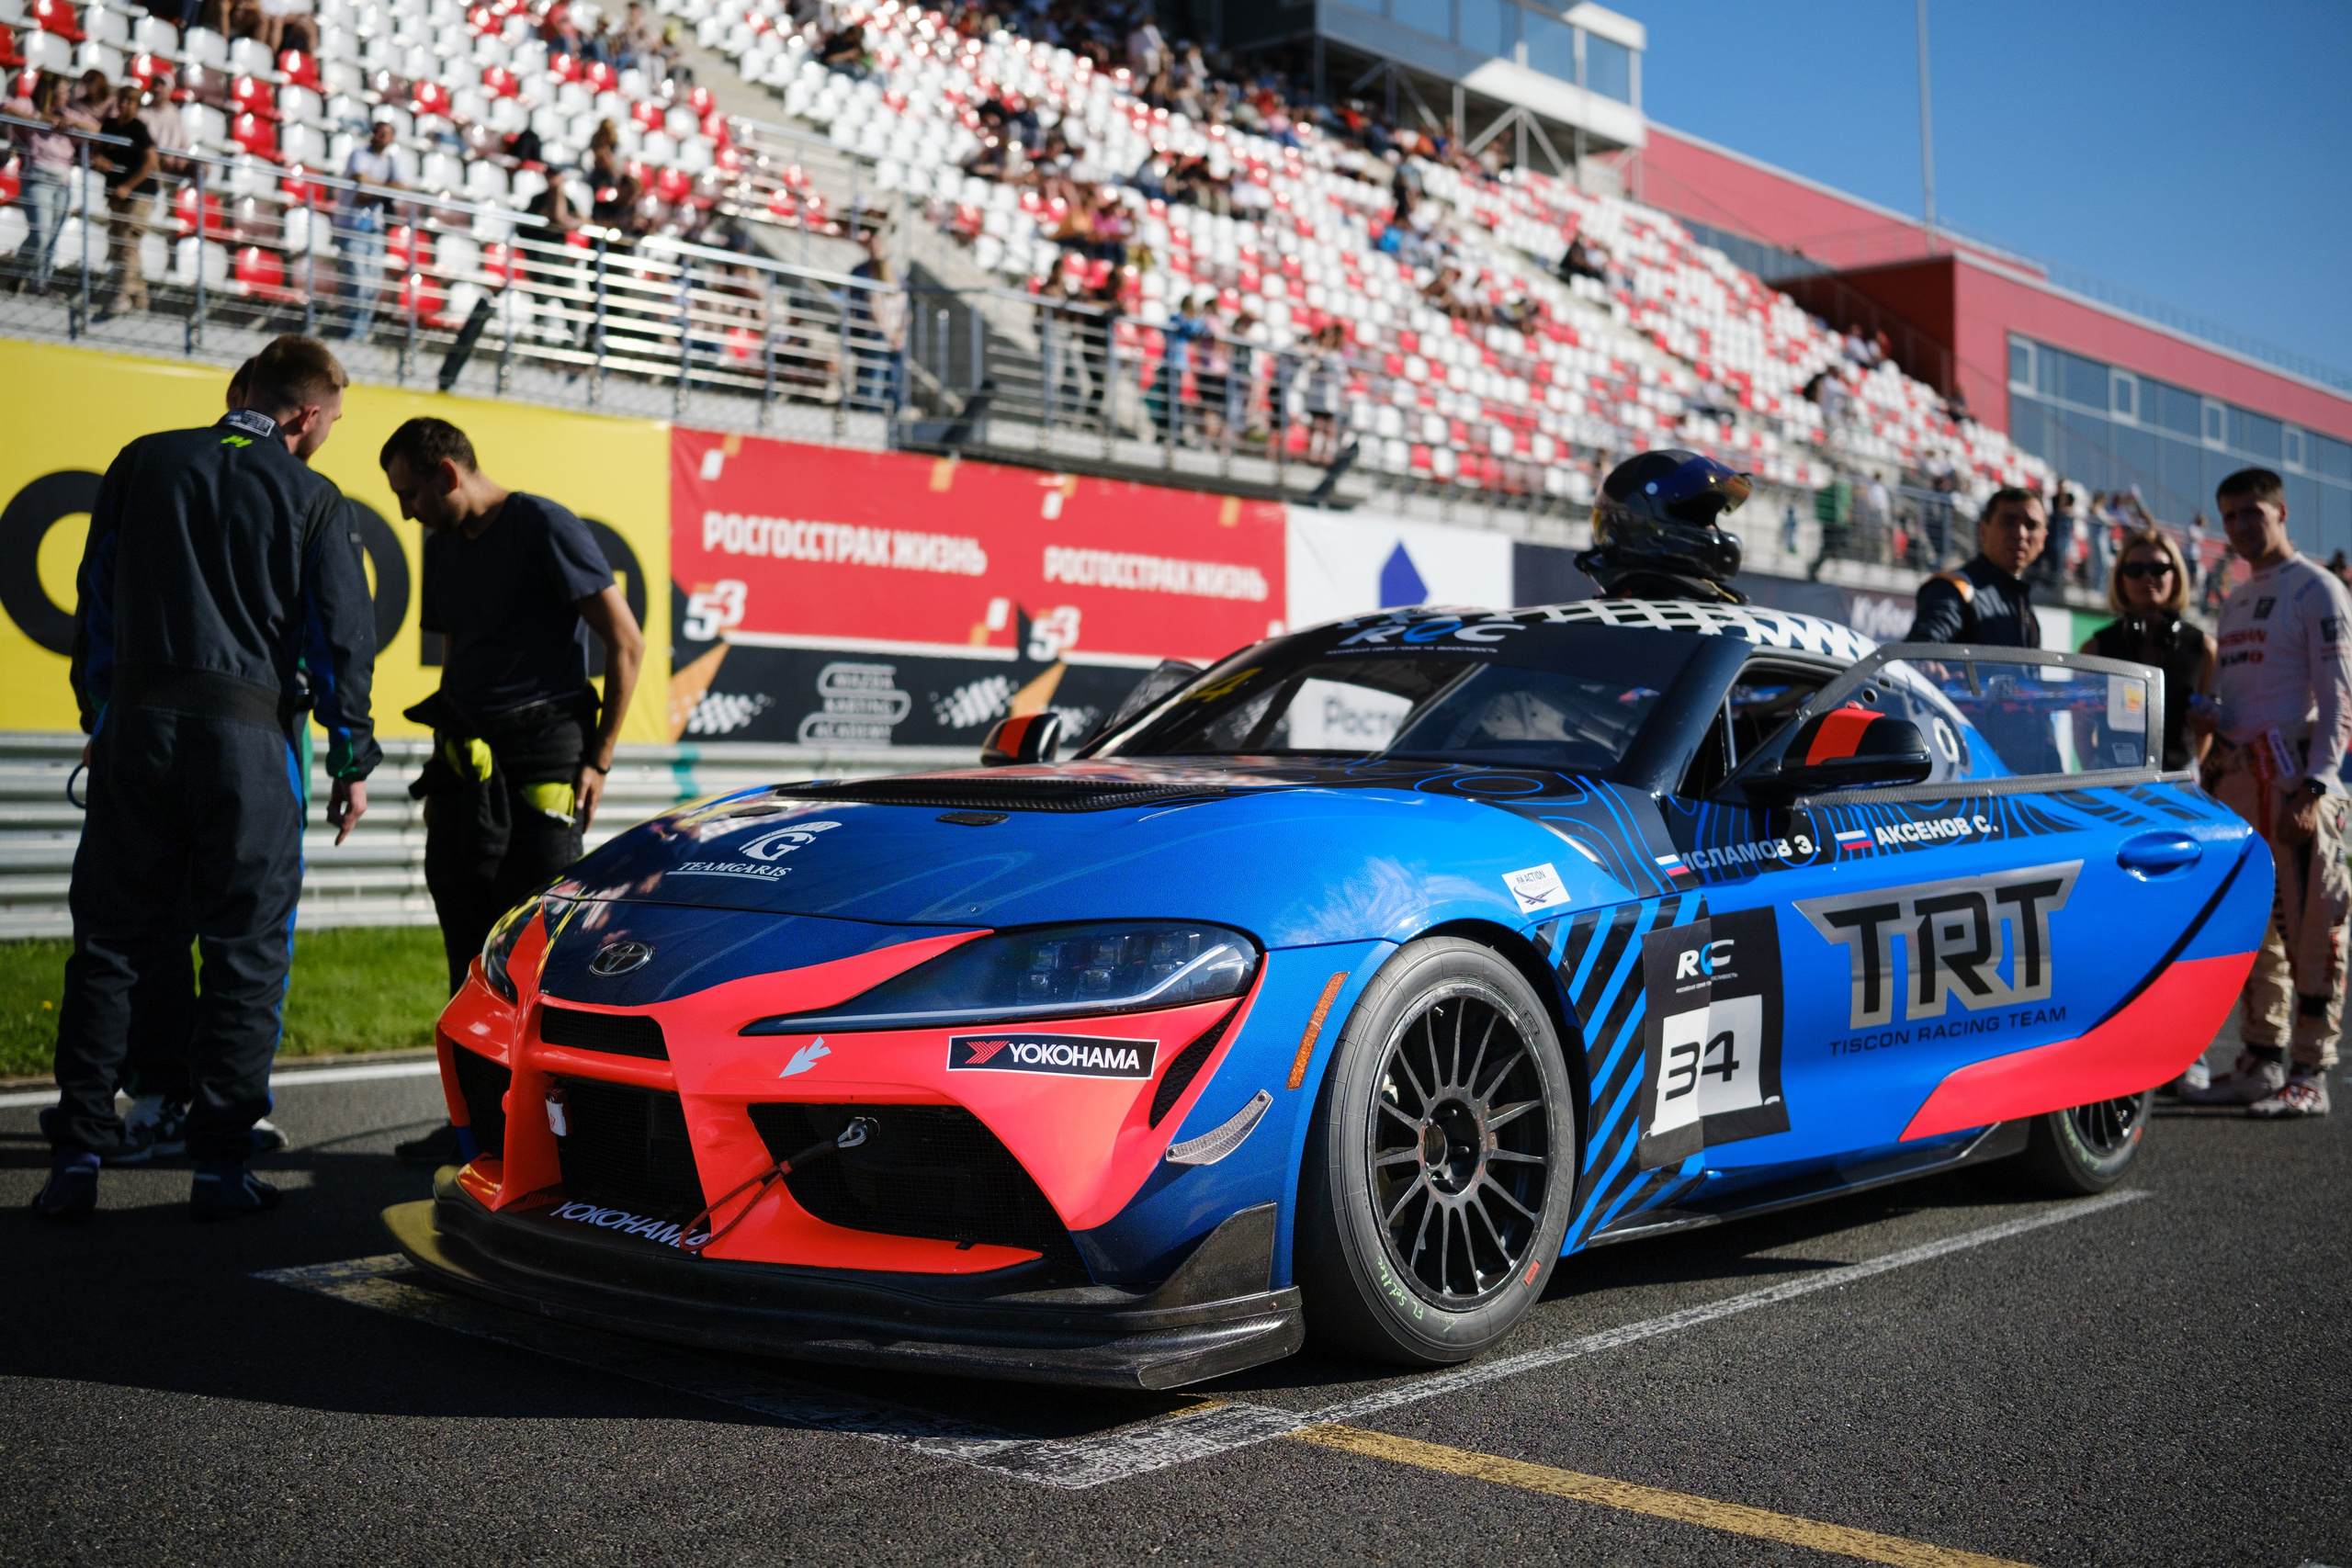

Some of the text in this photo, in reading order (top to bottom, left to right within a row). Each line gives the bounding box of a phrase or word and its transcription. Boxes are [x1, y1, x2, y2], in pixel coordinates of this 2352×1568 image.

[703, 510, 988, 577] РОСГОССТРАХ ЖИЗНЬ
[1043, 545, 1192, 595] РОСГОССТРАХ
[1793, 834, 1821, 854] Э.
[1874, 817, 1972, 846] АКСЕНОВ
[677, 862, 793, 877] TEAMGARIS
[1524, 870, 1546, 883] ACTION
[1822, 878, 2064, 1014] TRT
[1829, 1006, 2066, 1056] TISCON RACING TEAM
[1009, 1043, 1140, 1070] YOKOHAMA
[1665, 1030, 1739, 1101] 34
[549, 1201, 711, 1255] YOKOHAMA
